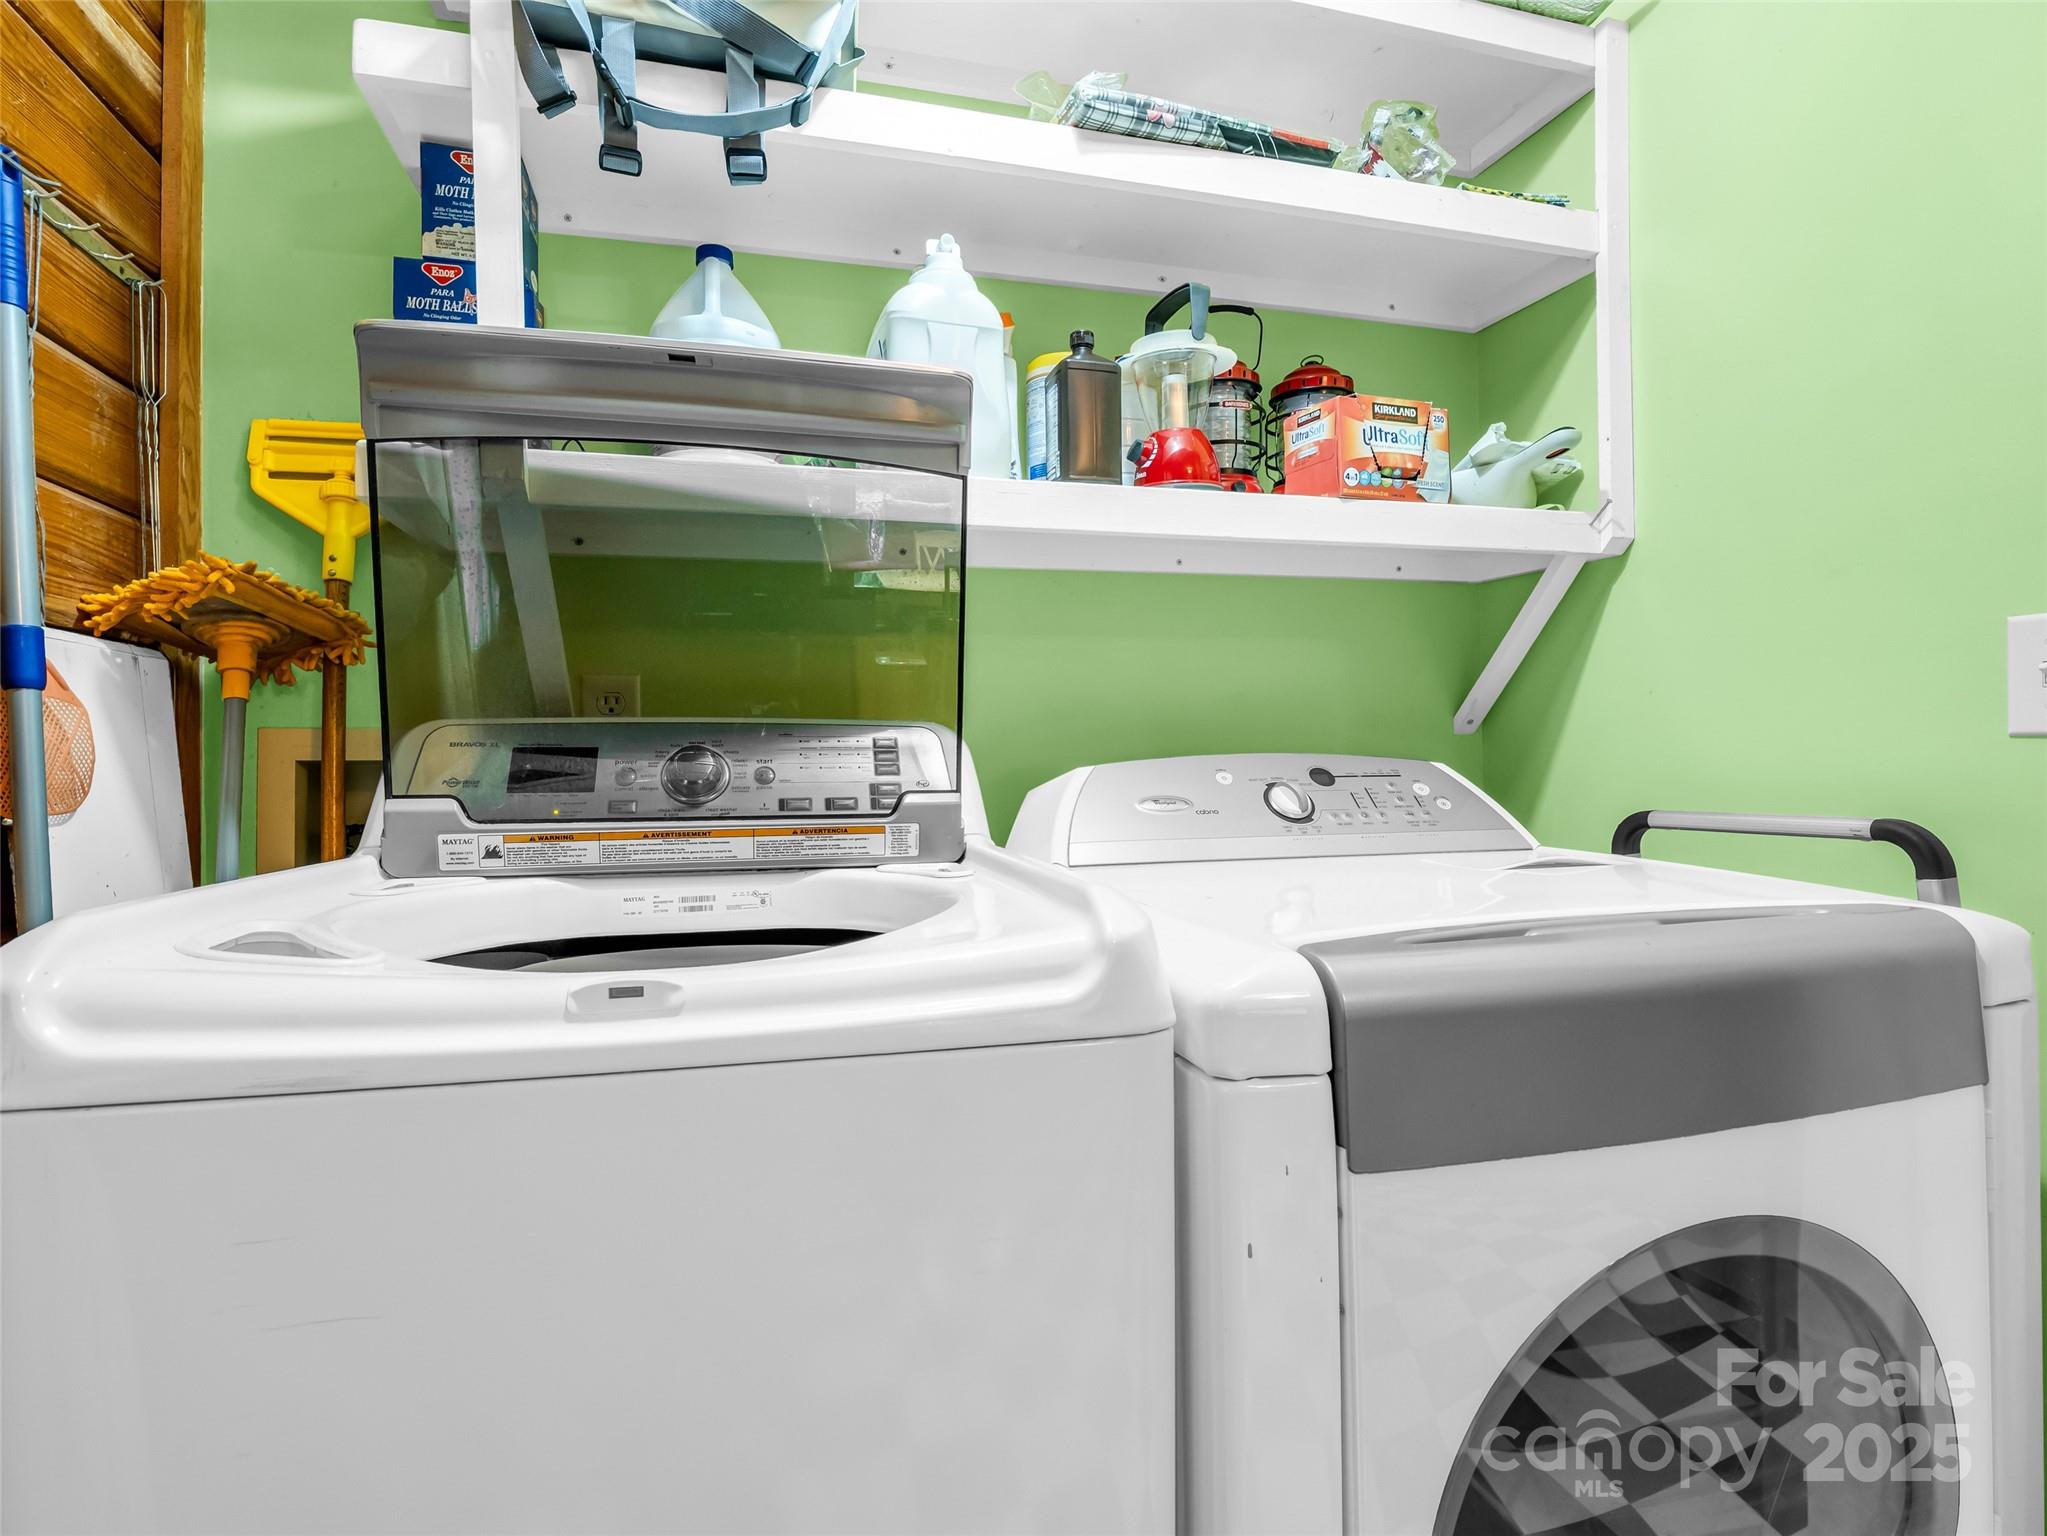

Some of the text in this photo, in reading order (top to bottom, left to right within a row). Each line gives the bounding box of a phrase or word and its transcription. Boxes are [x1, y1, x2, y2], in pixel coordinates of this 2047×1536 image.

[460, 154, 473, 165] En
[435, 183, 470, 199] MOTH
[431, 266, 455, 278] Enoz
[430, 287, 455, 297] PARA
[406, 295, 478, 316] MOTH BALLS
[1374, 404, 1417, 418] KIRKLAND
[1433, 415, 1445, 424] 250
[614, 759, 638, 767] power
[650, 831, 712, 839] AVERTISSEMENT
[799, 827, 848, 835] ADVERTENCIA
[441, 838, 475, 846] MAYTAG
[623, 895, 646, 903] MAYTAG
